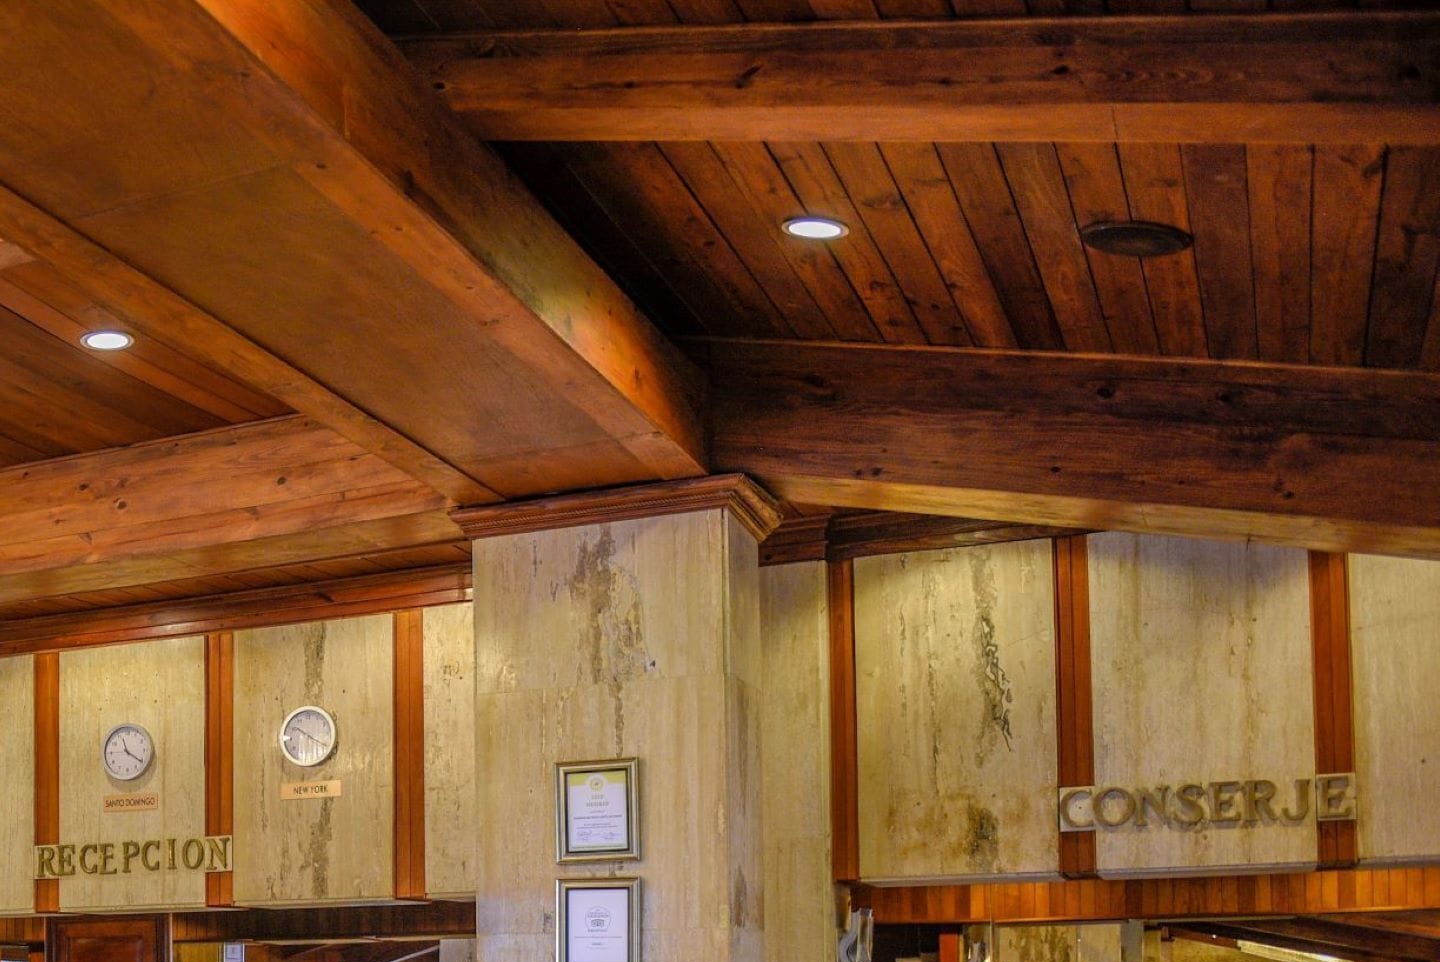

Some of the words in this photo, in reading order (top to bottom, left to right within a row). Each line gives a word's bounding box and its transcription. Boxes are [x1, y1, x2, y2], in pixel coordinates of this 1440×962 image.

[105, 798, 125, 808] SANTO
[125, 796, 156, 807] DOMINGO
[293, 785, 308, 795] NEW
[310, 784, 328, 794] YORK
[1060, 775, 1353, 828] CONSERJE
[37, 836, 231, 878] RECEPCION
